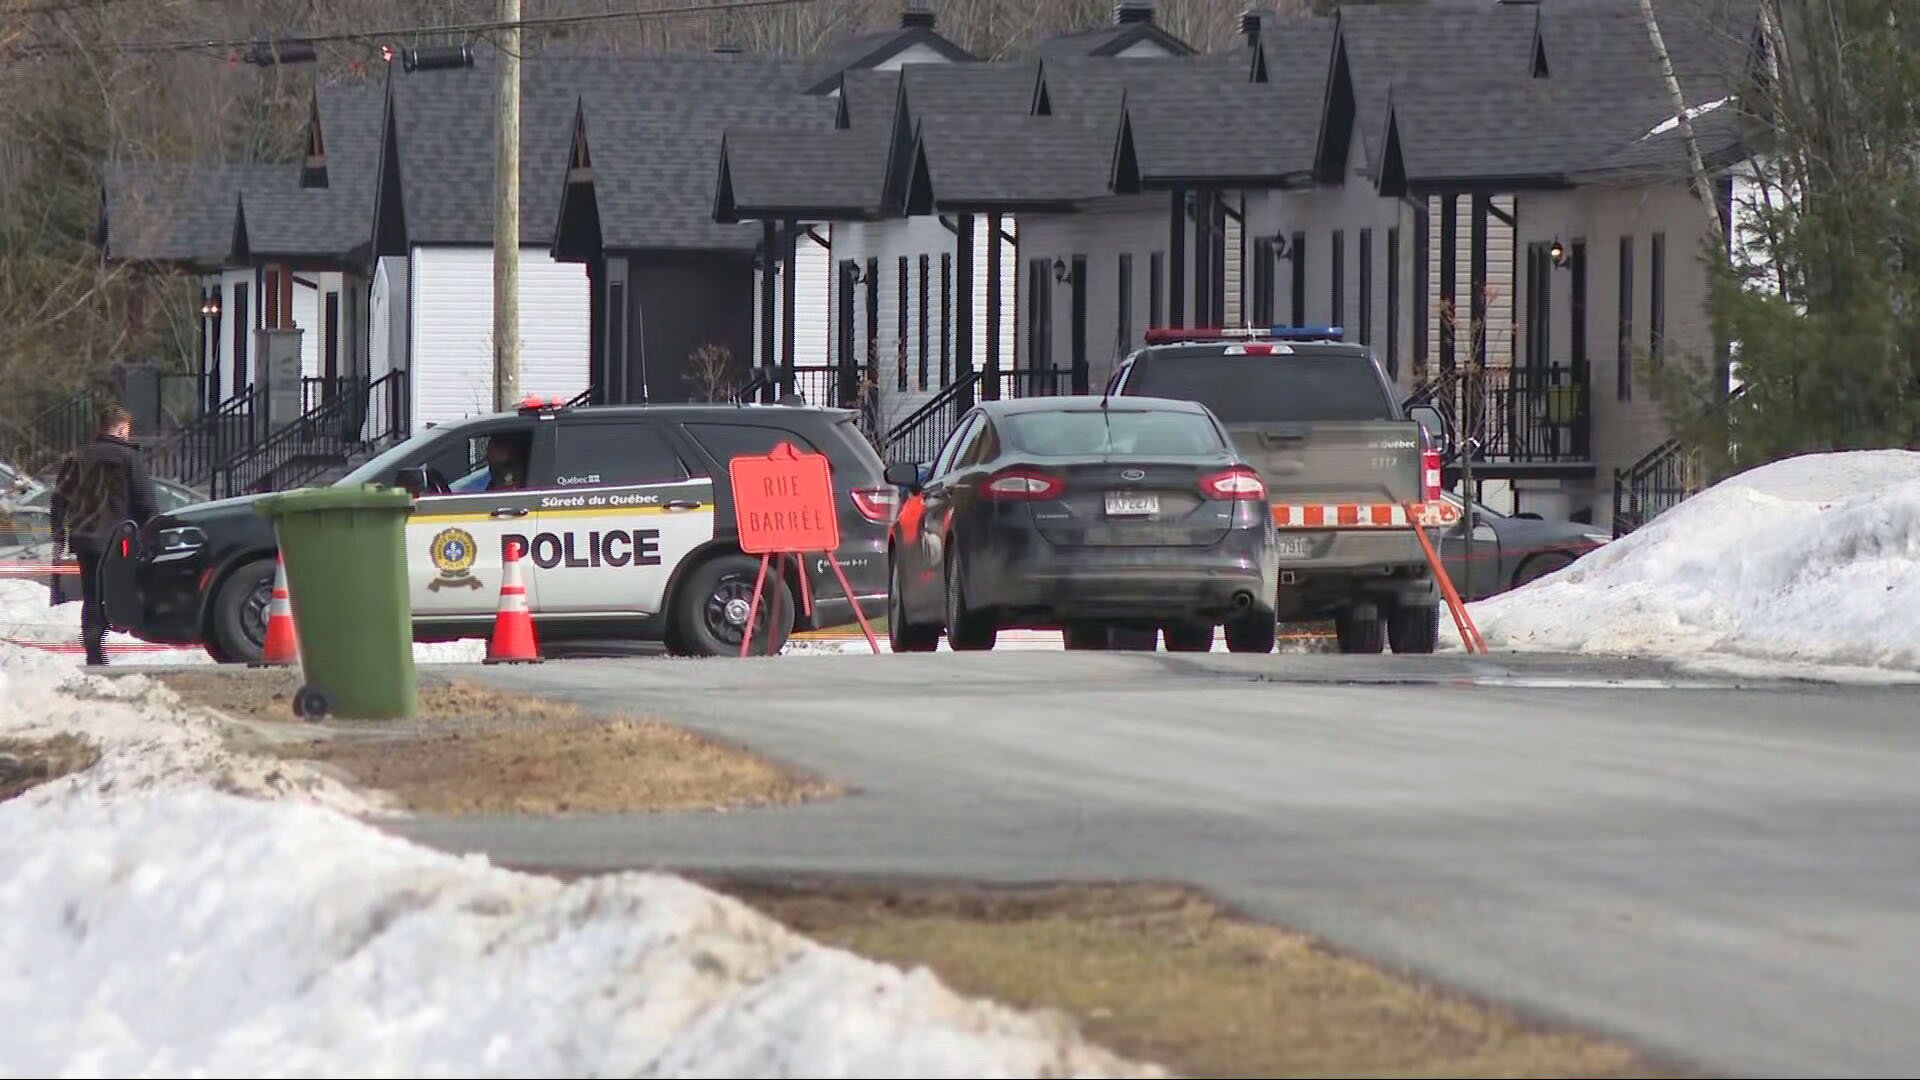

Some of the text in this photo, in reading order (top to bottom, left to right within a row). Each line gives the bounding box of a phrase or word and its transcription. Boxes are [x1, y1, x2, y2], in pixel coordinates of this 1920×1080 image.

[557, 476, 587, 486] Québec
[763, 475, 800, 497] RUE
[541, 493, 659, 508] Sûreté du Québec
[750, 505, 825, 533] BARRÉE
[501, 529, 661, 570] POLICE
